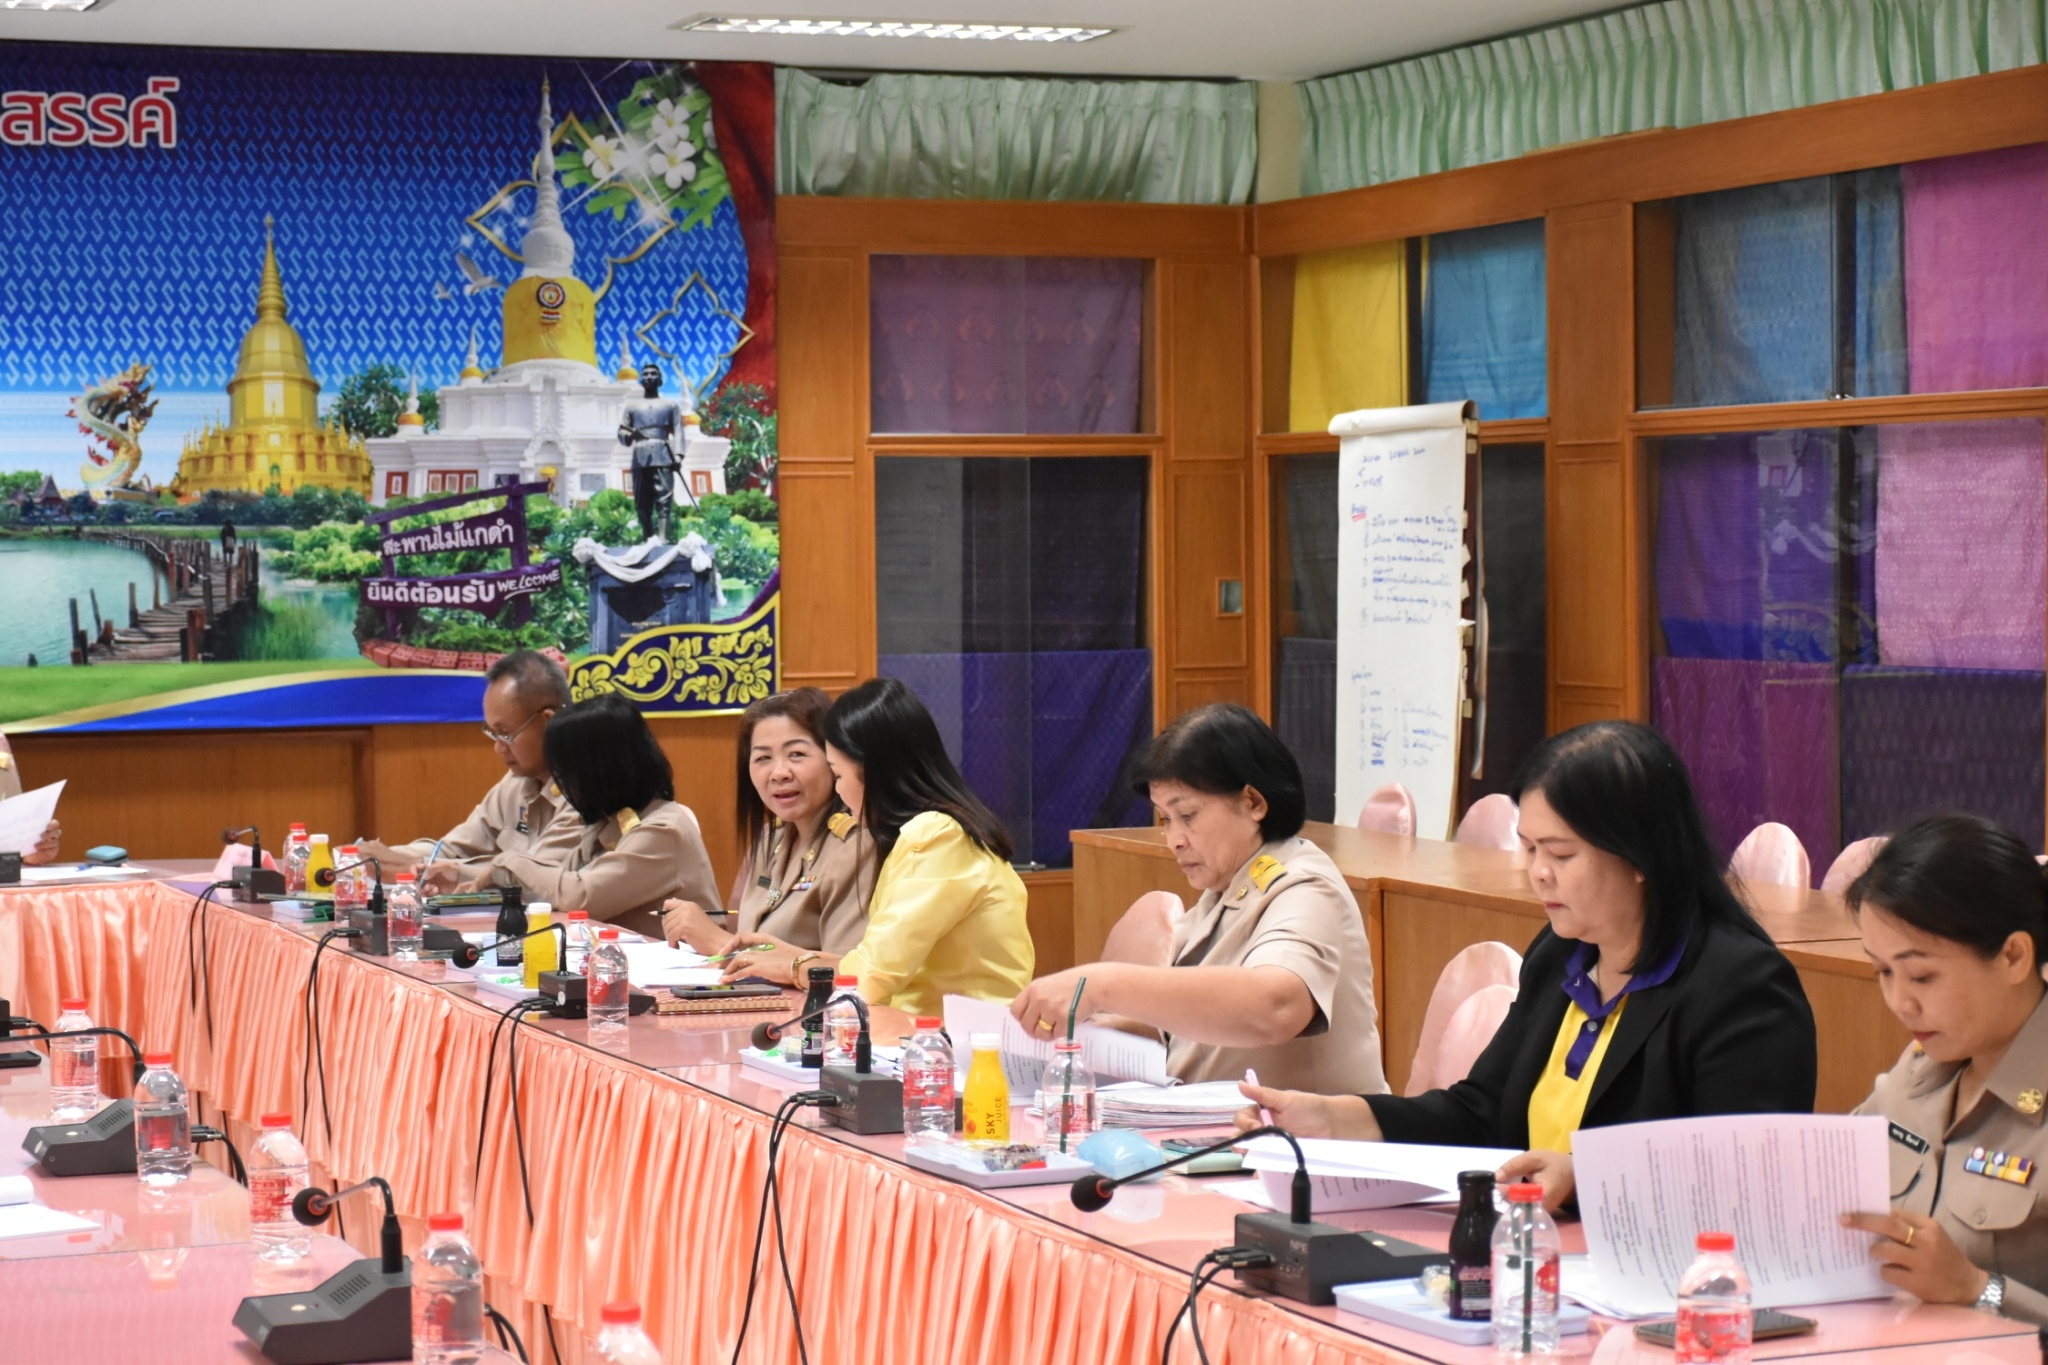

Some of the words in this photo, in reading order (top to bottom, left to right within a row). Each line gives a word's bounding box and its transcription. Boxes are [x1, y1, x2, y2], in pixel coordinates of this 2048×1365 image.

[0, 77, 180, 148] สรรค์
[383, 518, 514, 556] สะพานไม้แกดำ
[367, 579, 496, 604] ยินดีต้อนรับ
[497, 569, 560, 592] WELCOME
[994, 1096, 1003, 1124] JUICE
[986, 1112, 996, 1135] SKY
